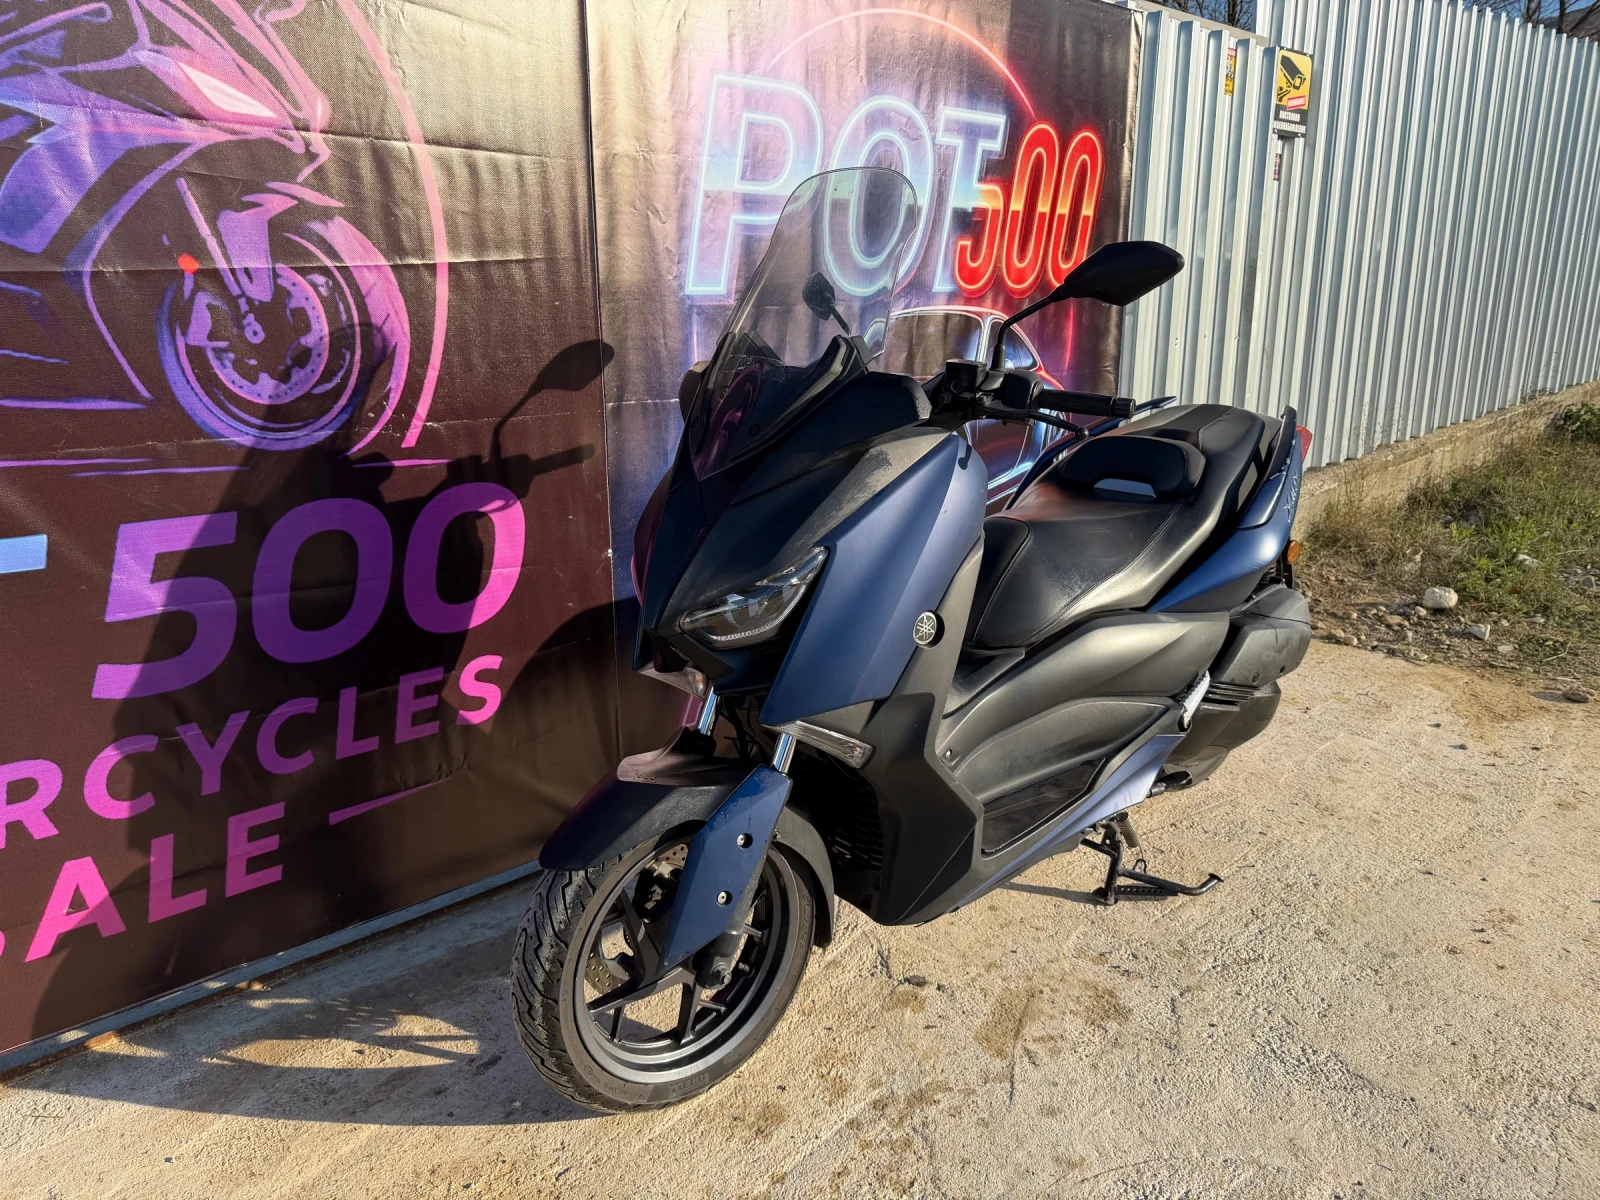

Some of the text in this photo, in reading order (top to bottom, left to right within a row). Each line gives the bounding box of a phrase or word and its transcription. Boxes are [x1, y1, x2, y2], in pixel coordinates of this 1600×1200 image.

[686, 71, 1007, 298] POT
[91, 481, 526, 700] 500
[0, 801, 285, 963] ALE
